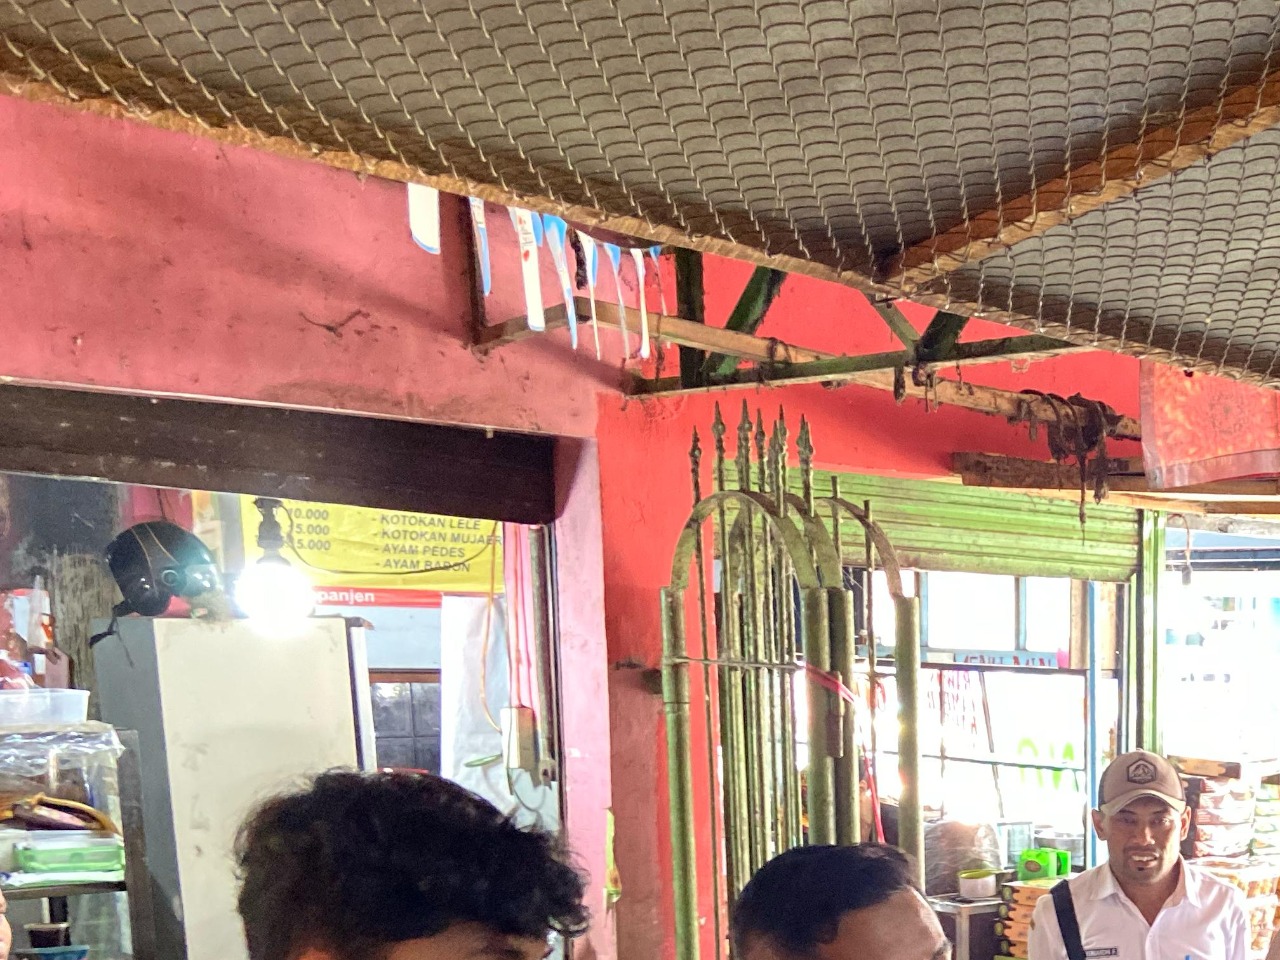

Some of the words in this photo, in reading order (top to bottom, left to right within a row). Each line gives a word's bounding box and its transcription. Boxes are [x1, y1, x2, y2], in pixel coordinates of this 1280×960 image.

[380, 513, 446, 528] KOTOKAN
[449, 518, 481, 530] LELE
[381, 528, 447, 543] KOTOKAN
[382, 543, 419, 555] AYAM
[422, 545, 466, 558] PEDES
[383, 558, 420, 570] AYAM
[318, 588, 376, 605] panjen
